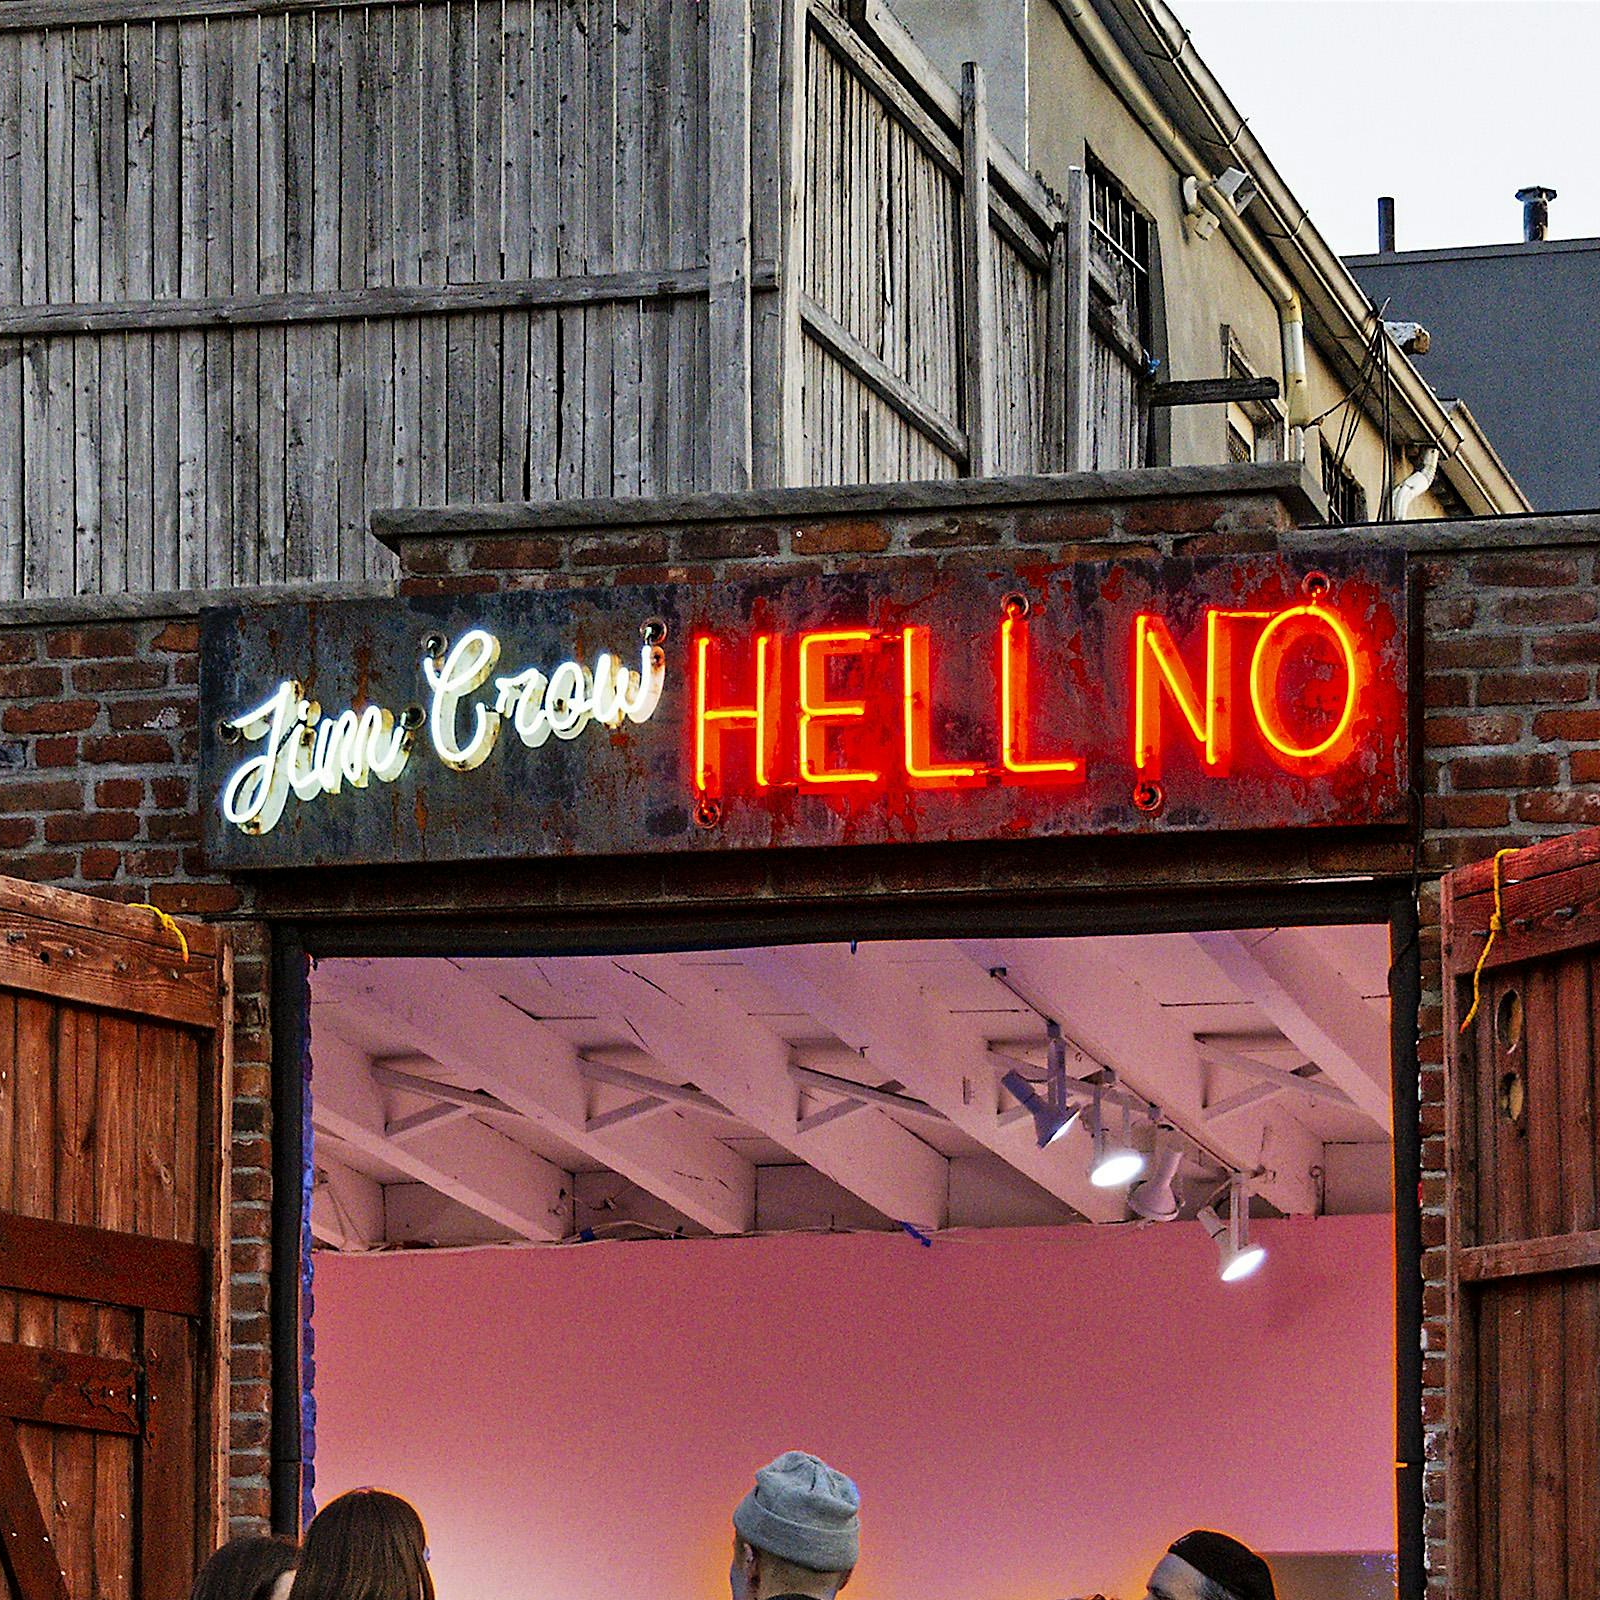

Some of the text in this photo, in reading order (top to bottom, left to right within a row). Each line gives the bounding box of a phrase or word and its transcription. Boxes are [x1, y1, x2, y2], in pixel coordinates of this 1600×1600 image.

[219, 604, 1358, 834] Jim Crow HELL NO
